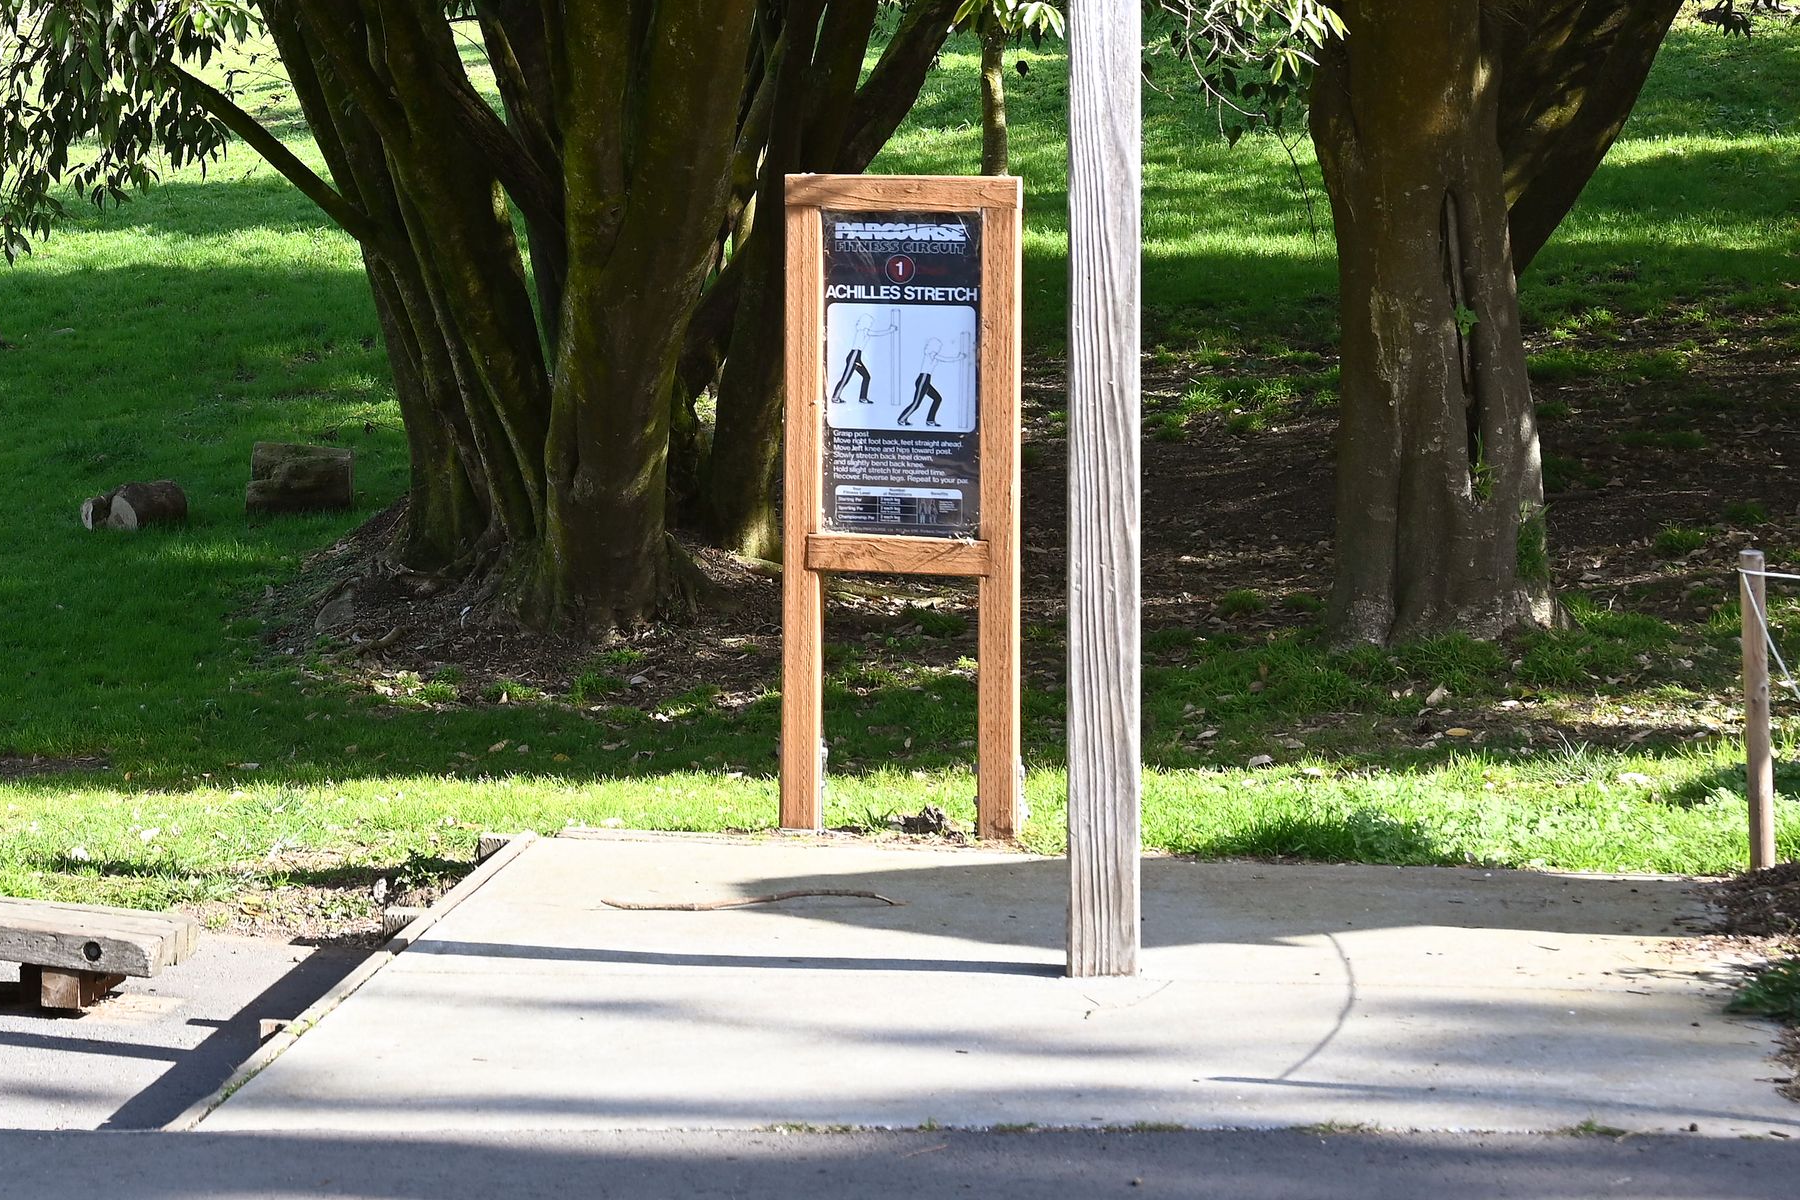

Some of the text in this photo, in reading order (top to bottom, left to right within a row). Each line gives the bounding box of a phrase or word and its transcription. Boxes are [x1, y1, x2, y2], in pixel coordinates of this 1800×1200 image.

[835, 222, 966, 241] PARCOURSE
[835, 240, 966, 254] FITNESS CIRCUIT
[895, 261, 903, 276] 1
[825, 285, 978, 301] ACHILLES STRETCH
[833, 430, 853, 438] Grasp
[852, 438, 867, 446] right
[915, 439, 939, 448] straight
[896, 446, 910, 454] hips
[833, 452, 854, 460] Slowly
[847, 459, 870, 467] slightly
[849, 466, 867, 474] slight
[907, 475, 931, 483] Repeat
